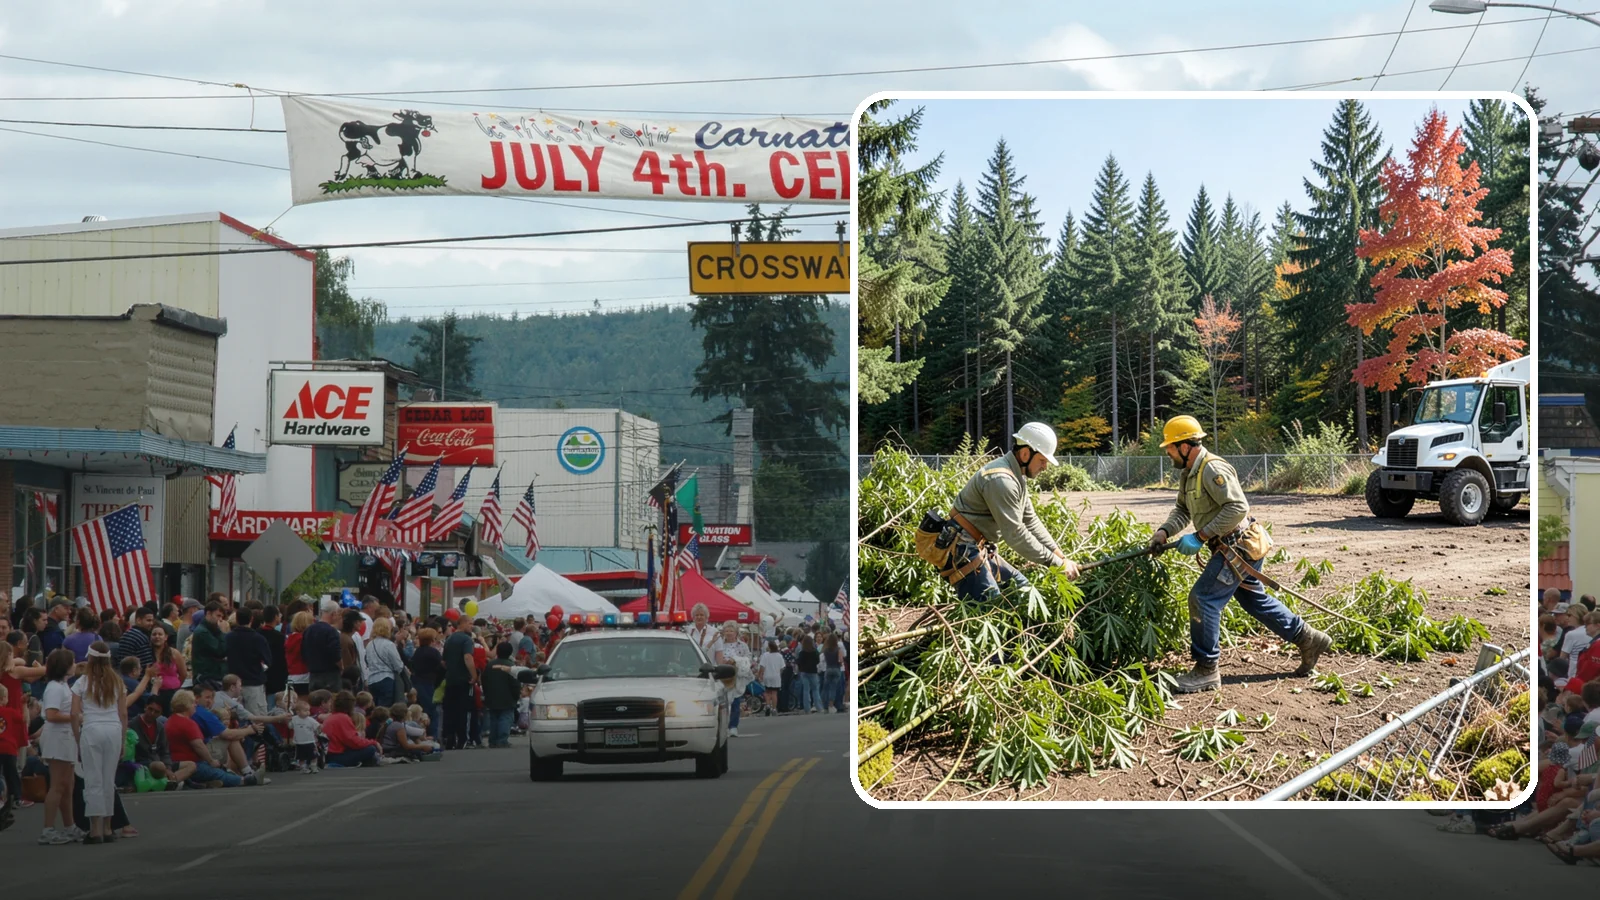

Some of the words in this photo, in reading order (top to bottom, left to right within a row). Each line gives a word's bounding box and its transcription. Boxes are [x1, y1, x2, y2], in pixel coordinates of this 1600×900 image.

[481, 141, 605, 192] JULY
[632, 150, 746, 198] 4th.
[697, 254, 850, 280] CROSSWA
[283, 380, 373, 420] ACE
[406, 410, 452, 421] CEDAR
[284, 421, 370, 436] Hardware
[416, 428, 476, 447] Coca-Cola
[95, 485, 124, 494] Vincent
[126, 486, 135, 494] de
[138, 486, 155, 495] Paul
[688, 526, 741, 535] CRNATION
[699, 535, 730, 543] GLASS
